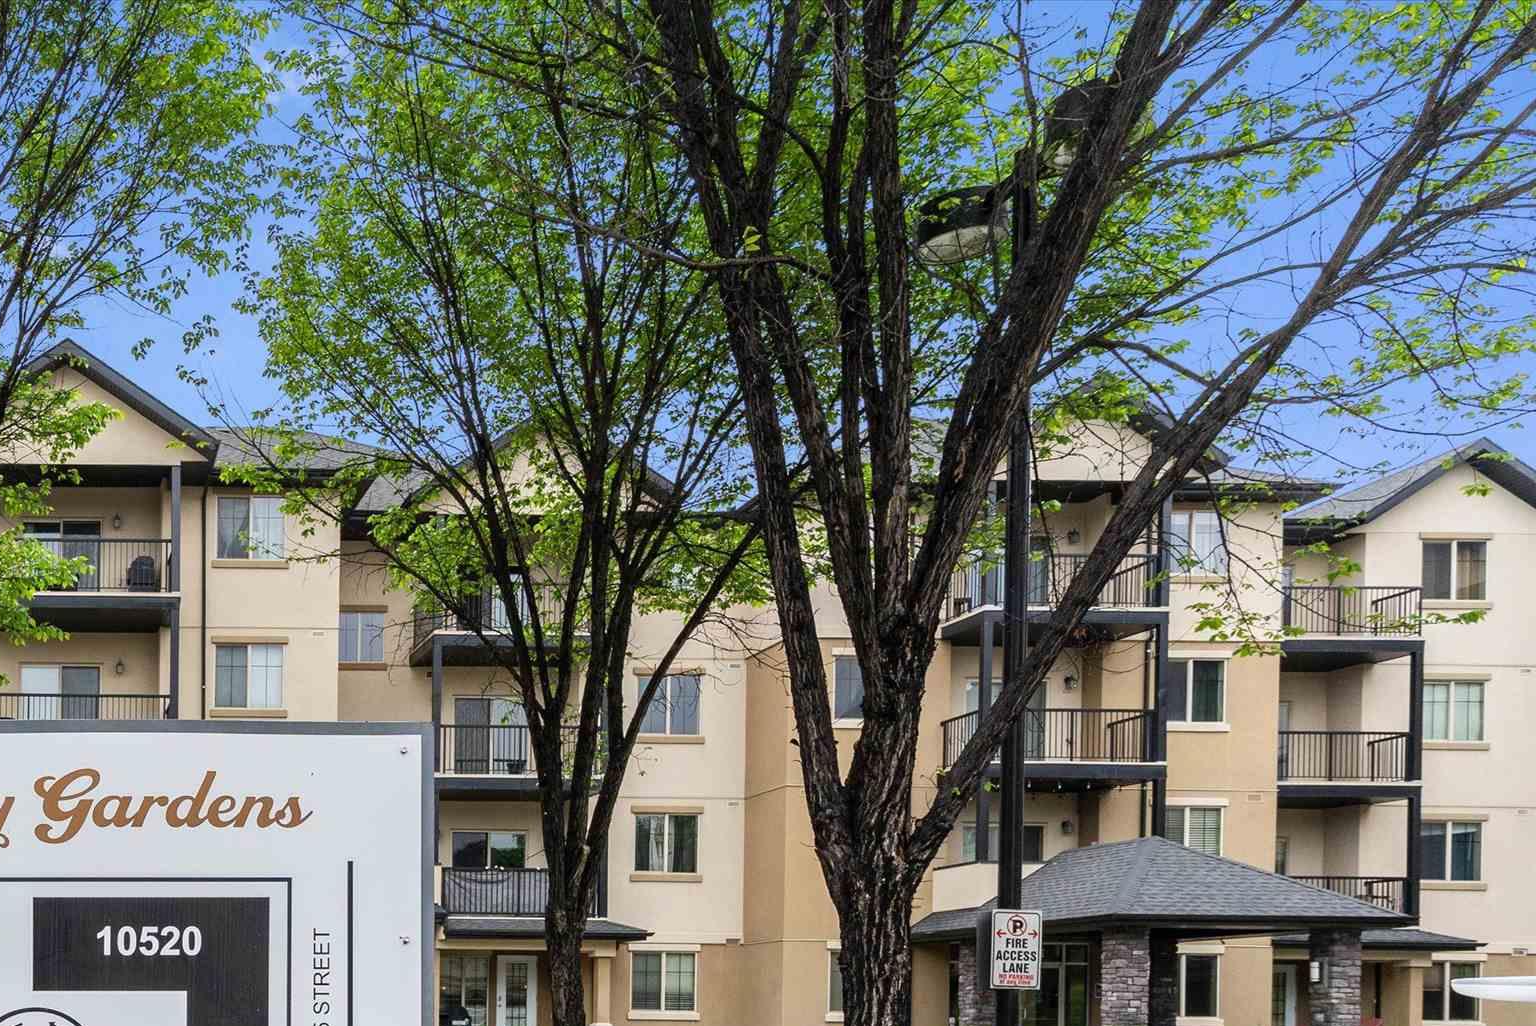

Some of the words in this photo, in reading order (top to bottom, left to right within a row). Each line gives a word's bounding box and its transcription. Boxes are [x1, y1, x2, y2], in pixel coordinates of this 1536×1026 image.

[33, 767, 313, 844] Gardens
[95, 925, 203, 957] 10520
[1006, 938, 1028, 949] FIRE
[995, 950, 1038, 962] ACCESS
[312, 927, 331, 1015] STREET
[1002, 963, 1030, 974] LANE
